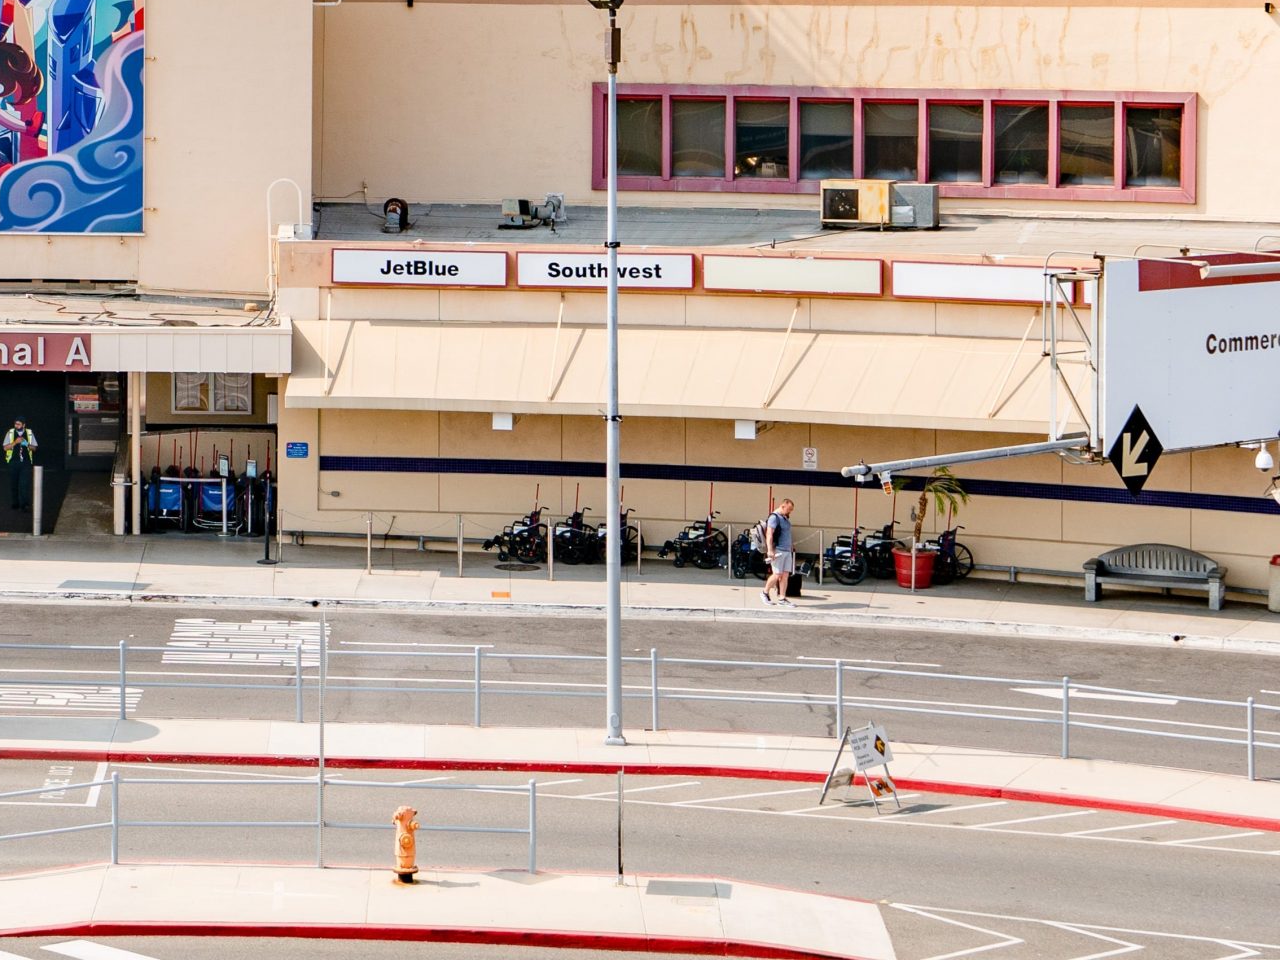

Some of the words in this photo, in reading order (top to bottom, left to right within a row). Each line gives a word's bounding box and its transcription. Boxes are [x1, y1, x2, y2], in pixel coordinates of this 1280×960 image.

[380, 259, 460, 277] JetBlue
[65, 337, 90, 366] A
[1205, 332, 1280, 355] Commer
